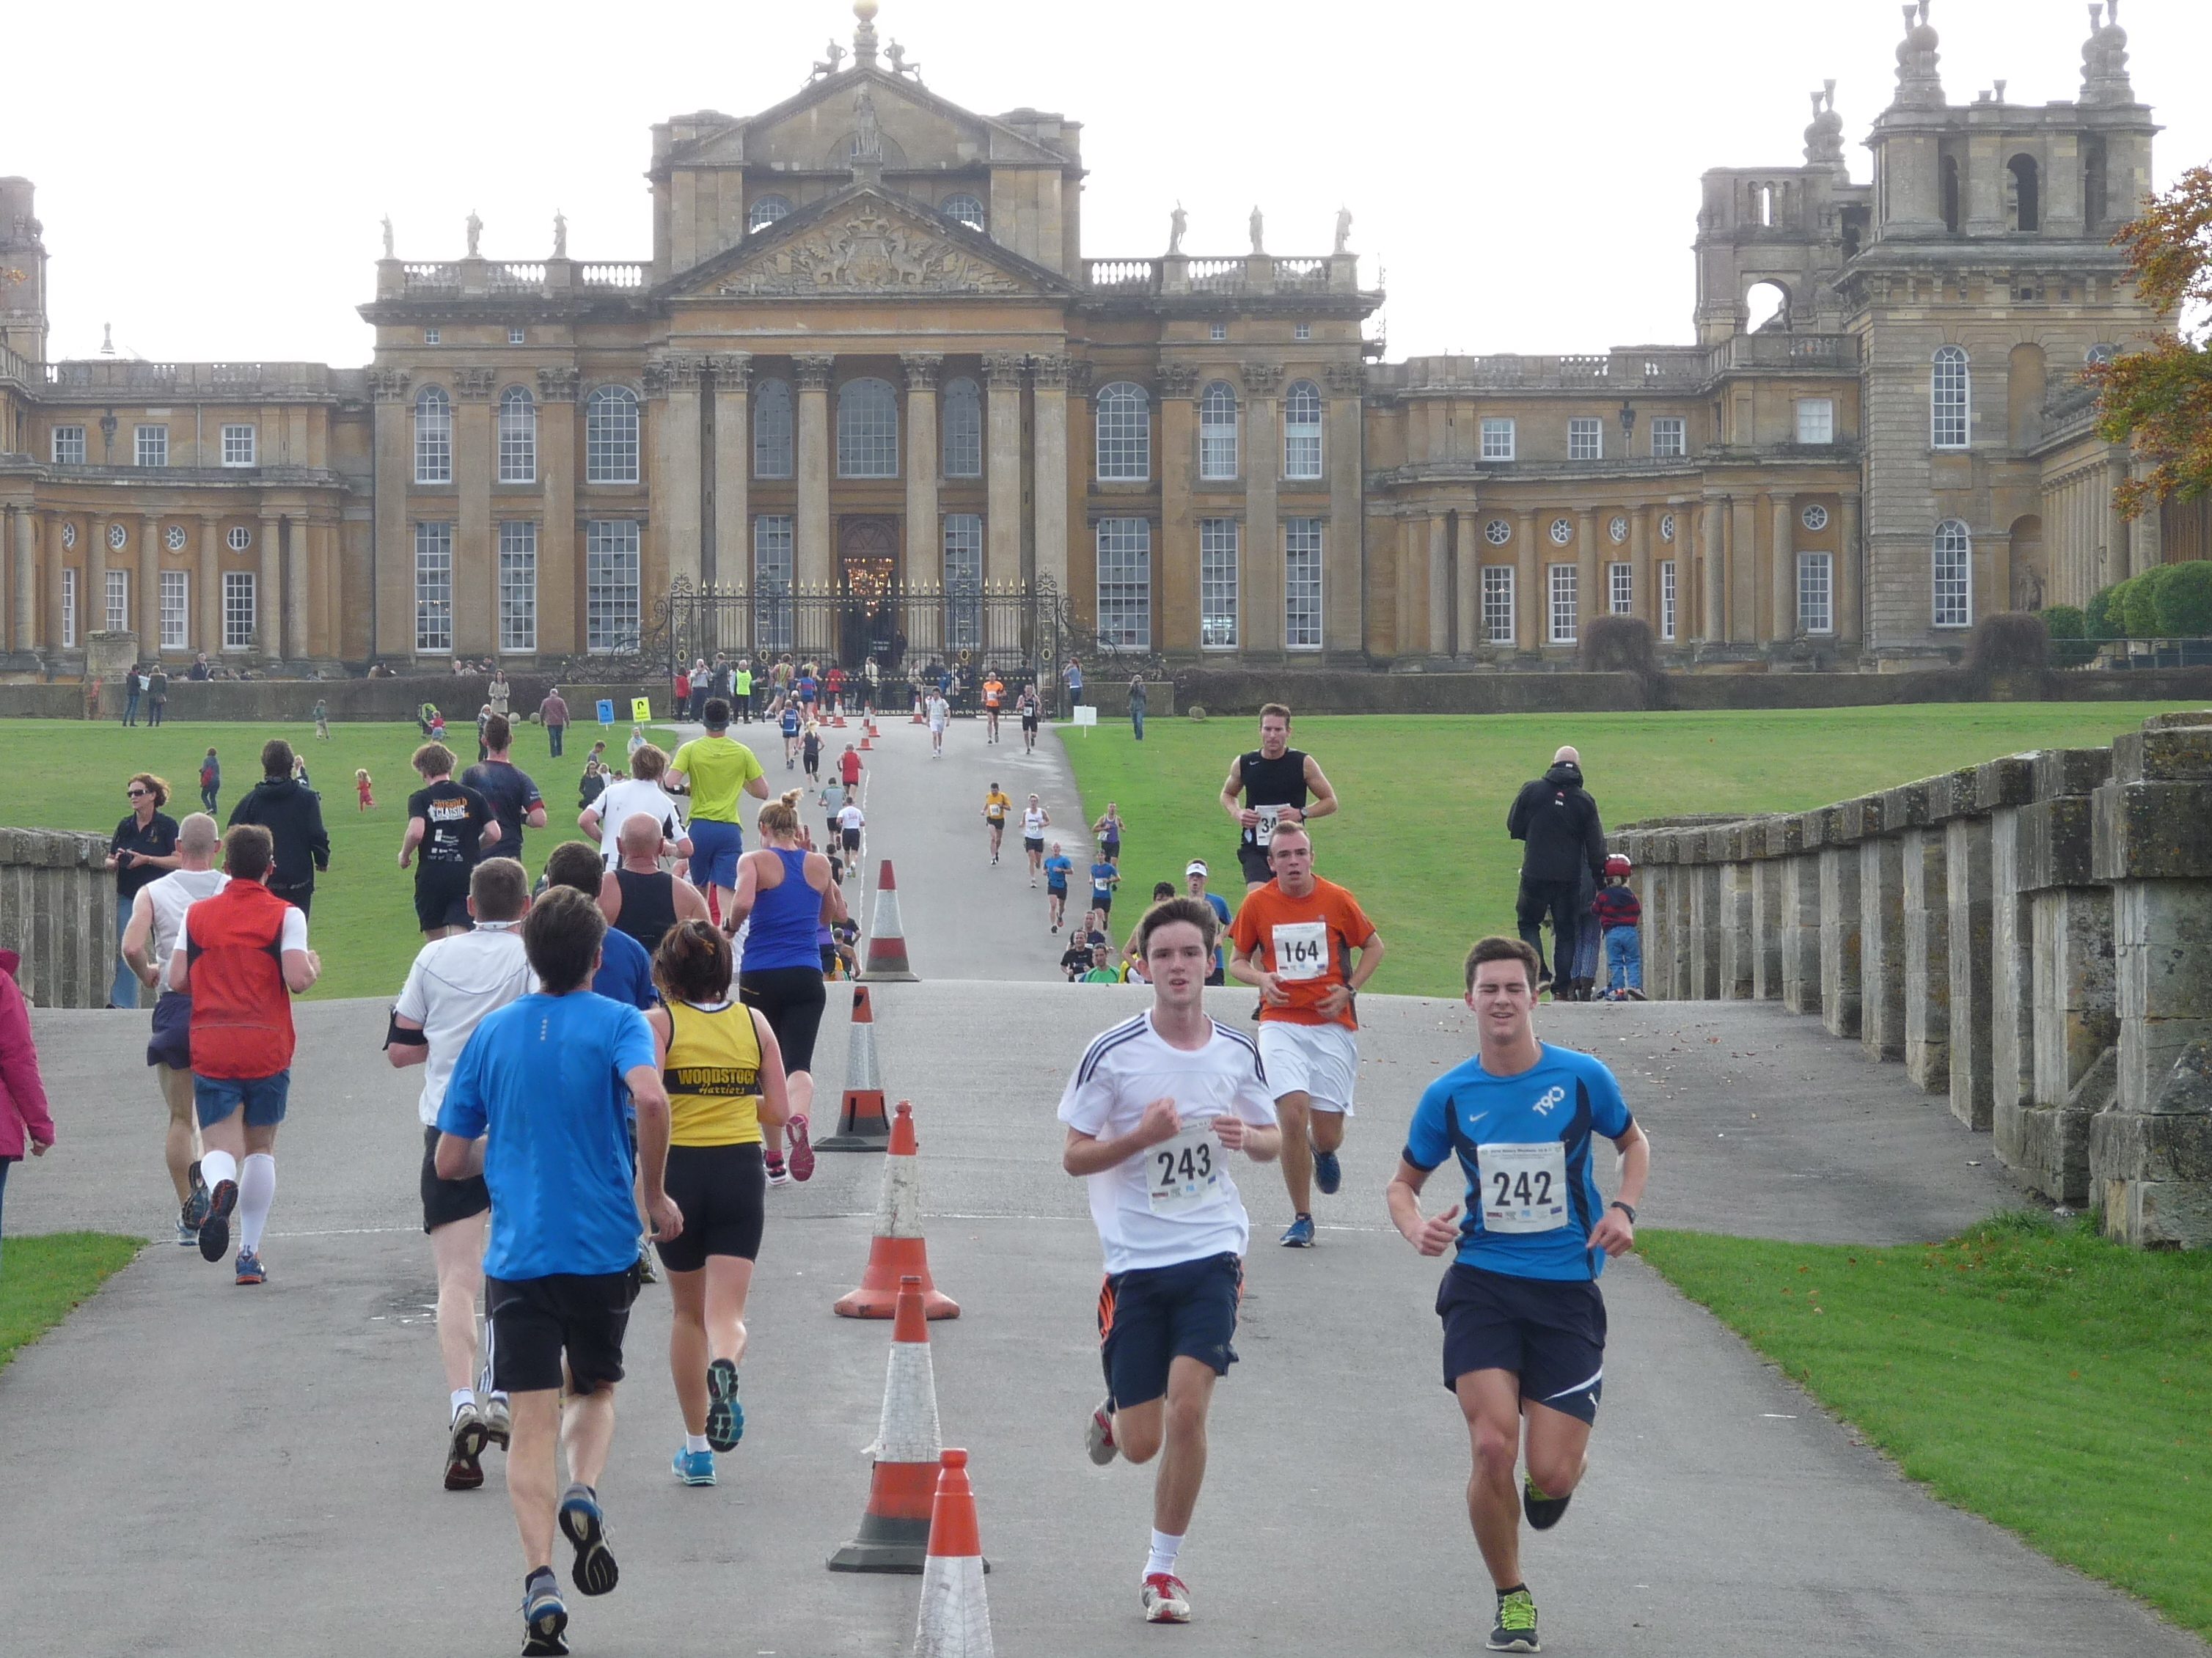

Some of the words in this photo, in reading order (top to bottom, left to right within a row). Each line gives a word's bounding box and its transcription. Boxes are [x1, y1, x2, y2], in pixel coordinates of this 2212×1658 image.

[1285, 941, 1319, 962] 164
[677, 1068, 755, 1085] WOODSTOCK
[1532, 1086, 1564, 1115] T90
[1157, 1142, 1211, 1186] 243
[1493, 1171, 1553, 1206] 242
